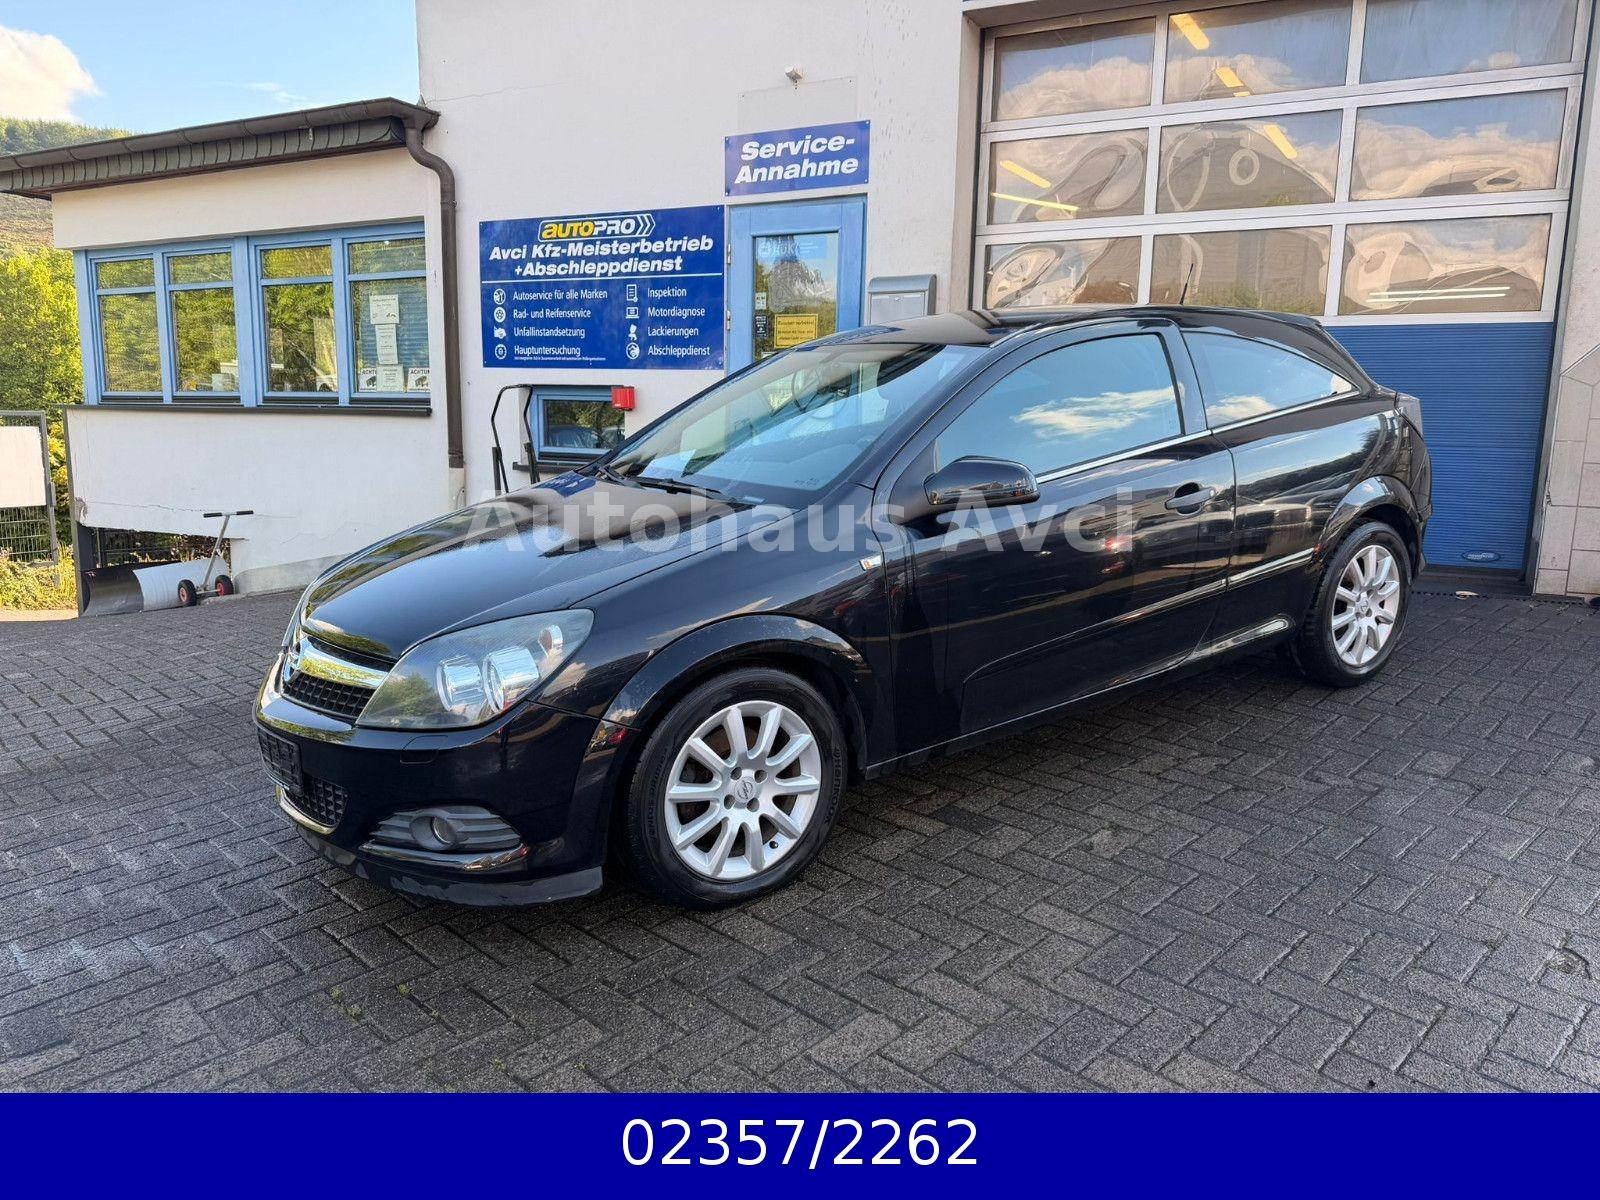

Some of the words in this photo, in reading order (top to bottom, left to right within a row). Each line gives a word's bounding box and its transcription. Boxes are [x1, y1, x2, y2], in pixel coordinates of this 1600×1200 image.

[741, 134, 855, 161] Service-
[734, 157, 859, 184] Annahme
[489, 246, 526, 261] Avci
[532, 235, 714, 259] Kfz-Meisterbetrieb
[515, 256, 682, 277] +Abschleppdienst
[513, 290, 554, 301] Autoservice
[555, 290, 566, 300] für
[567, 290, 579, 300] alle
[580, 289, 608, 300] Marken
[647, 287, 687, 299] Inspektion
[513, 309, 530, 319] Rad-
[530, 309, 544, 319] und
[545, 308, 591, 319] Reifenservice
[647, 306, 705, 318] Motordiagnose
[513, 327, 586, 339] Unfallinstandsetzung
[647, 326, 699, 338] Lackierungen
[514, 345, 581, 357] Hauptuntersuchung
[647, 345, 711, 357] Abschleppdienst
